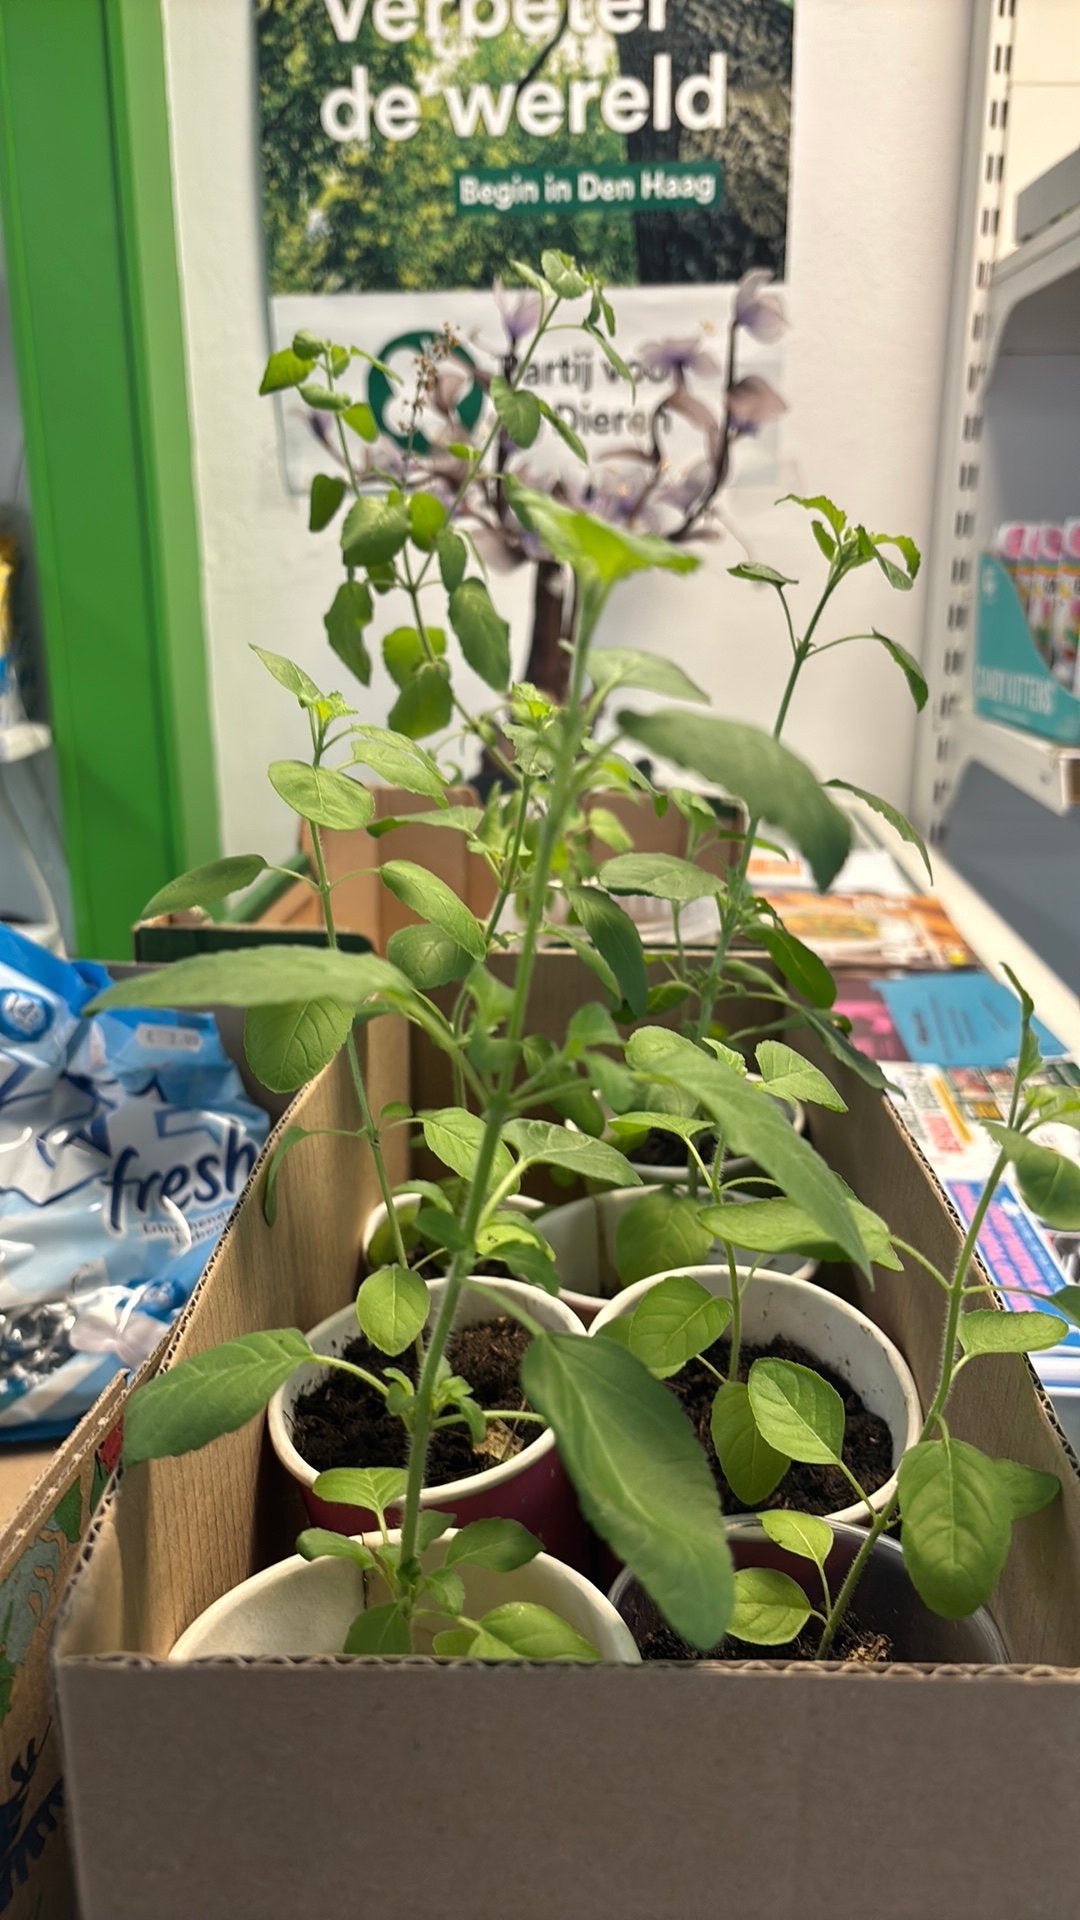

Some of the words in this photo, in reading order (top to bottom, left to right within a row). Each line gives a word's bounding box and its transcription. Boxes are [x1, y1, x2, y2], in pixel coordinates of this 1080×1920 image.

[320, 65, 421, 142] de
[443, 52, 727, 138] wereld
[459, 174, 540, 211] Begin
[544, 172, 573, 203] in
[577, 171, 636, 202] Den
[640, 169, 716, 206] Haag
[101, 1124, 258, 1231] fresh
